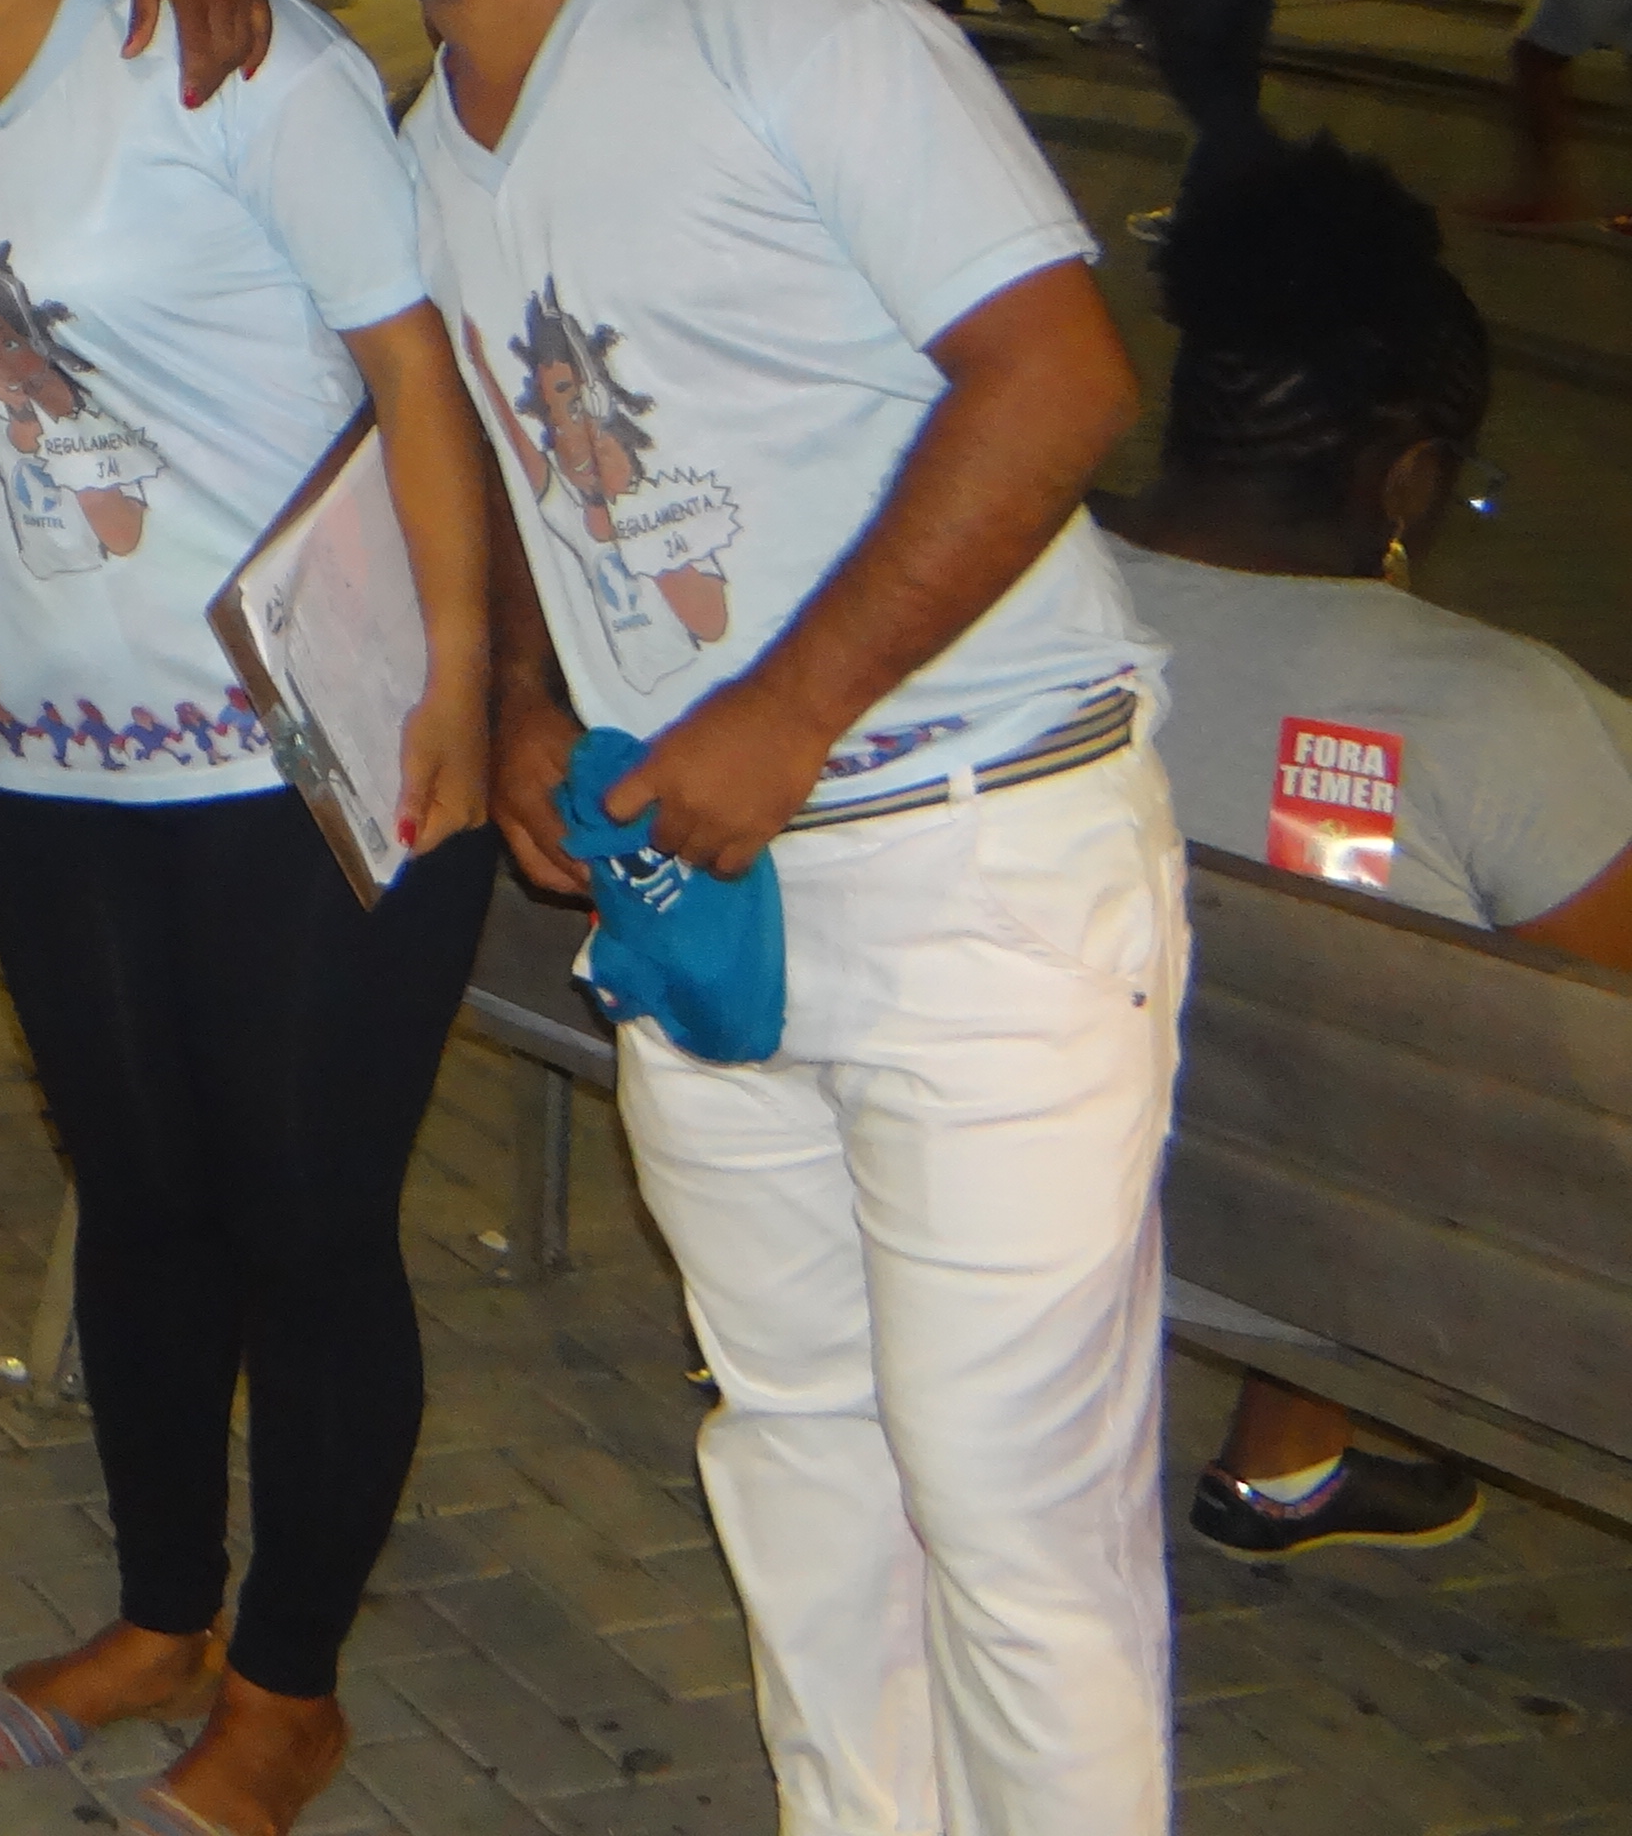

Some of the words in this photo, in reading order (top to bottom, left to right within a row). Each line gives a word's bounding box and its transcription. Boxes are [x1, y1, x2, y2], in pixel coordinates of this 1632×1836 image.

[616, 494, 714, 538] EGULAMENTA
[1294, 731, 1385, 778] FORA
[1280, 764, 1396, 813] TEMER
